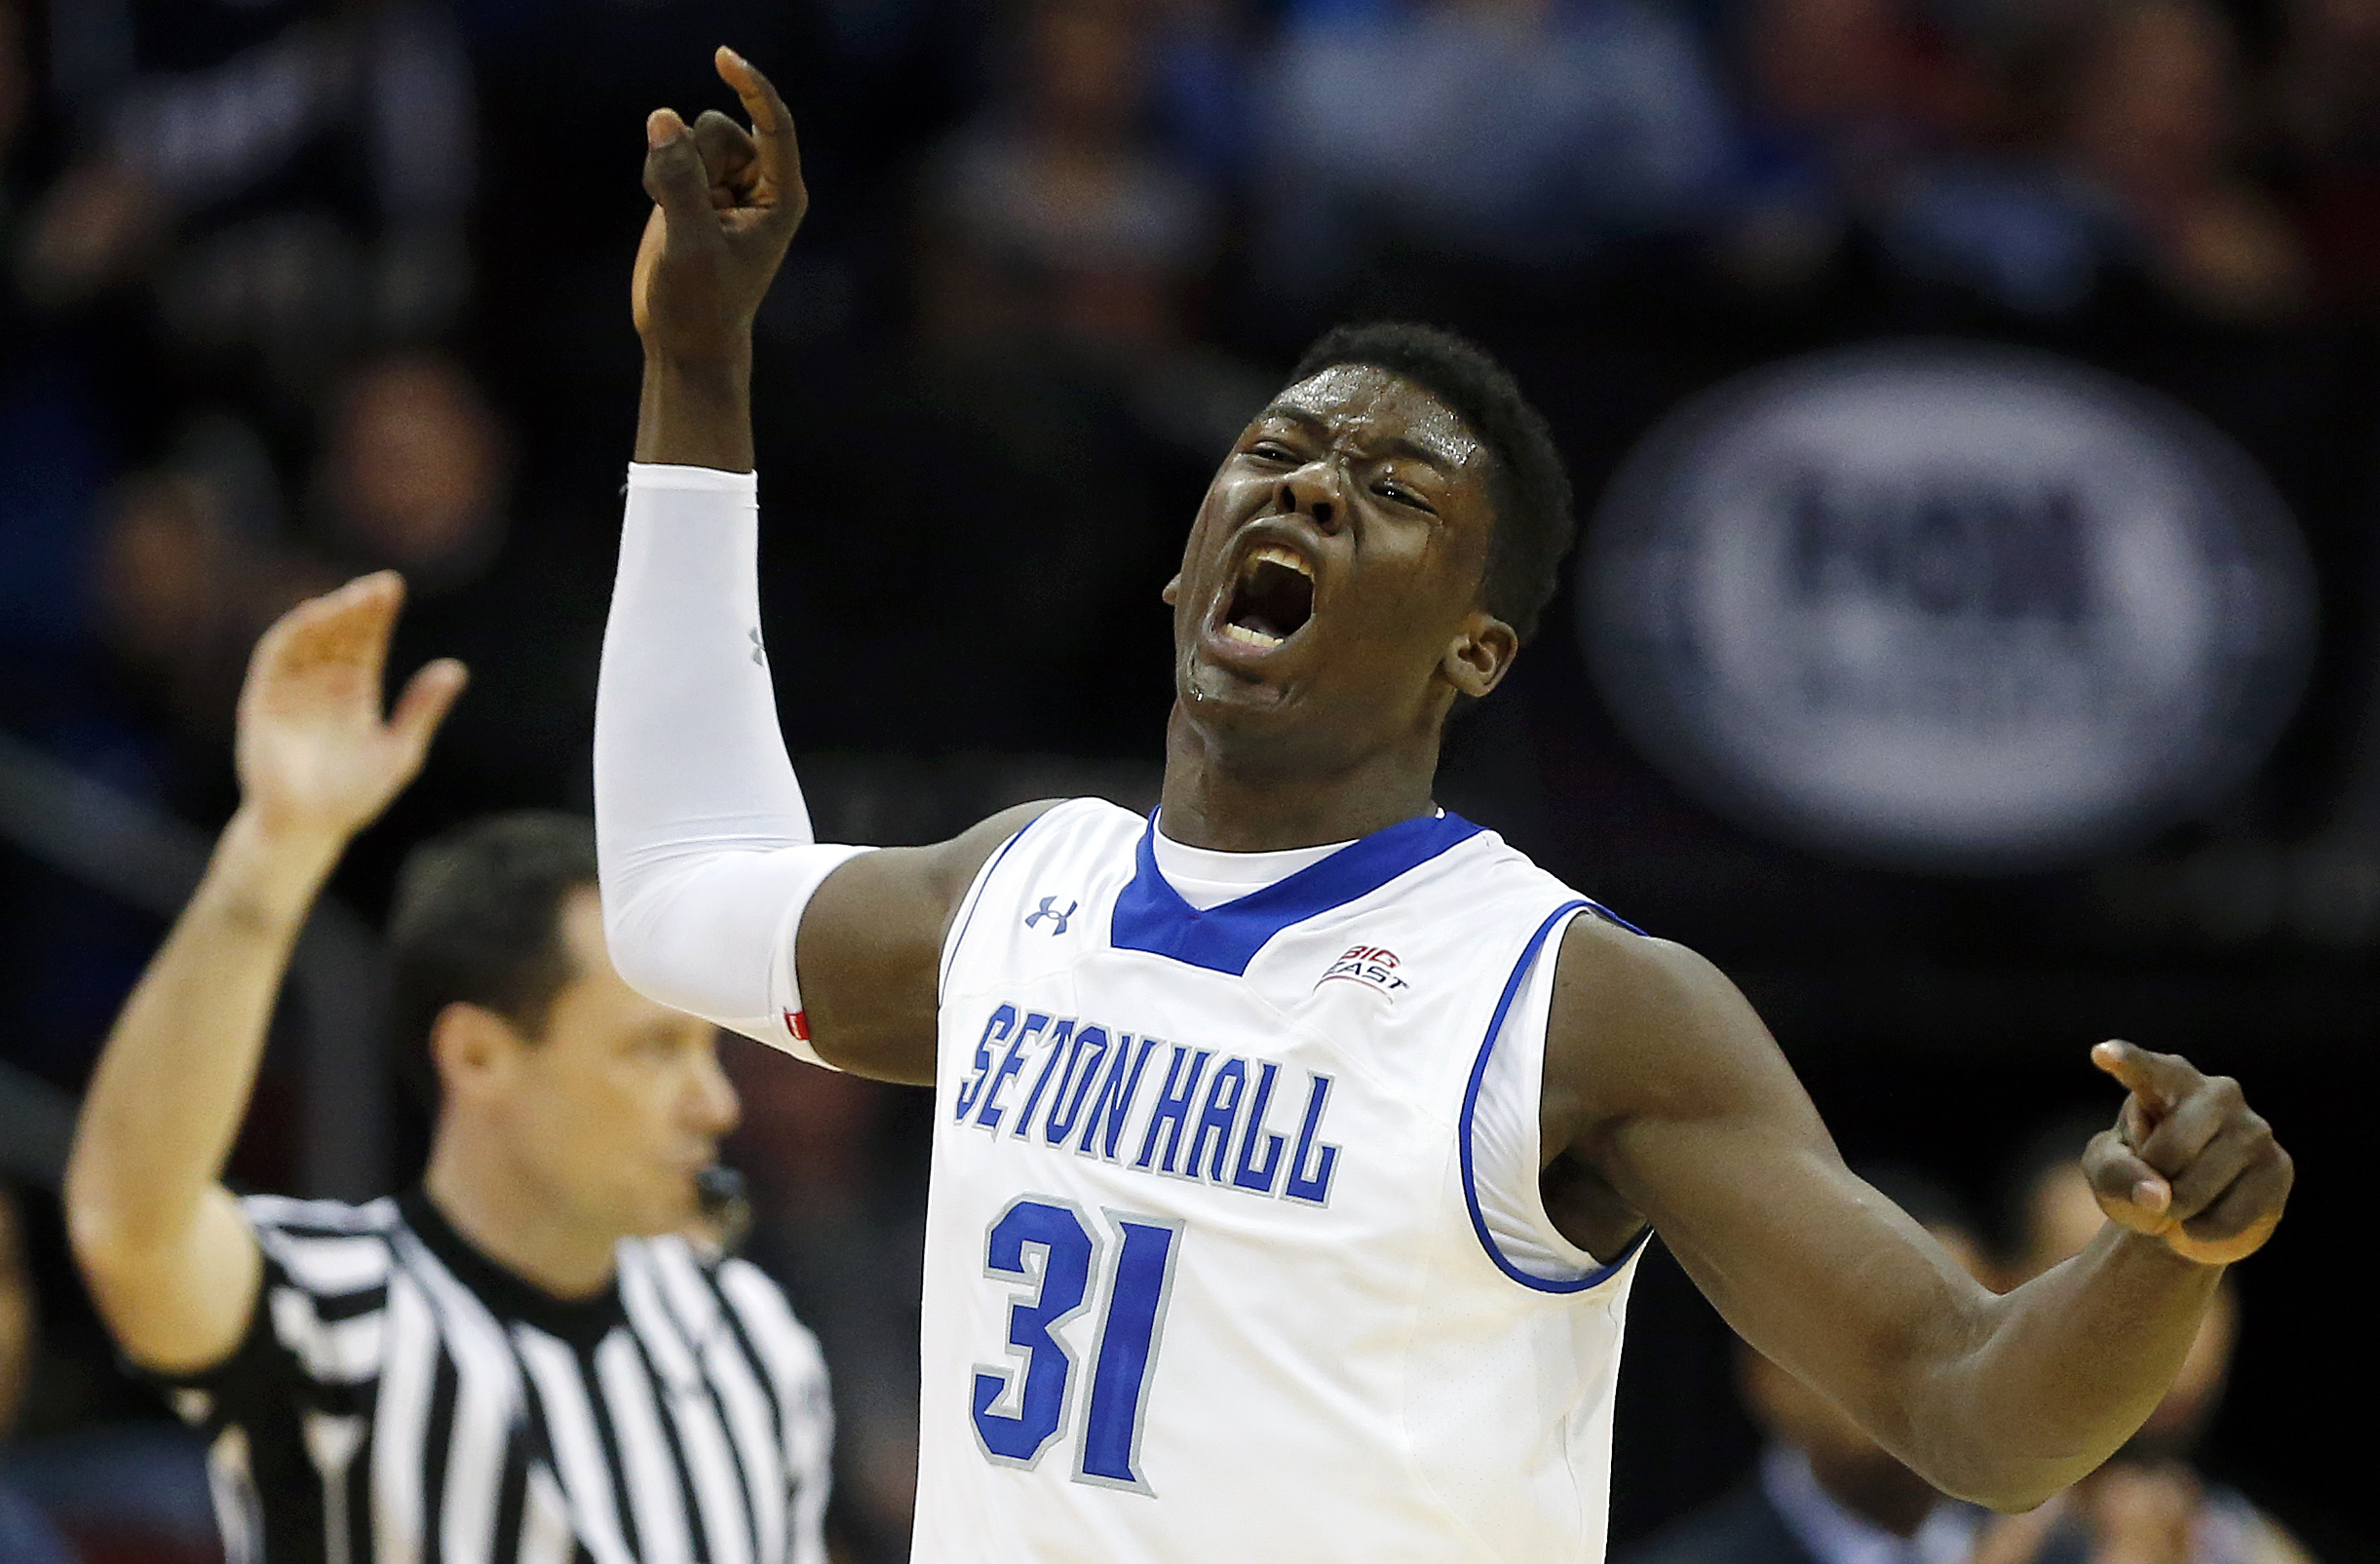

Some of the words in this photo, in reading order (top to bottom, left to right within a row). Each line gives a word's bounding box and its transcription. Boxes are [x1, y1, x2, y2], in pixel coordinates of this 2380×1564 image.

[1322, 961, 1409, 989] EAST
[1338, 944, 1401, 969] BIG
[953, 1001, 1166, 1166] SETON
[1127, 1042, 1342, 1208] HALL
[969, 1190, 1186, 1498] 31
